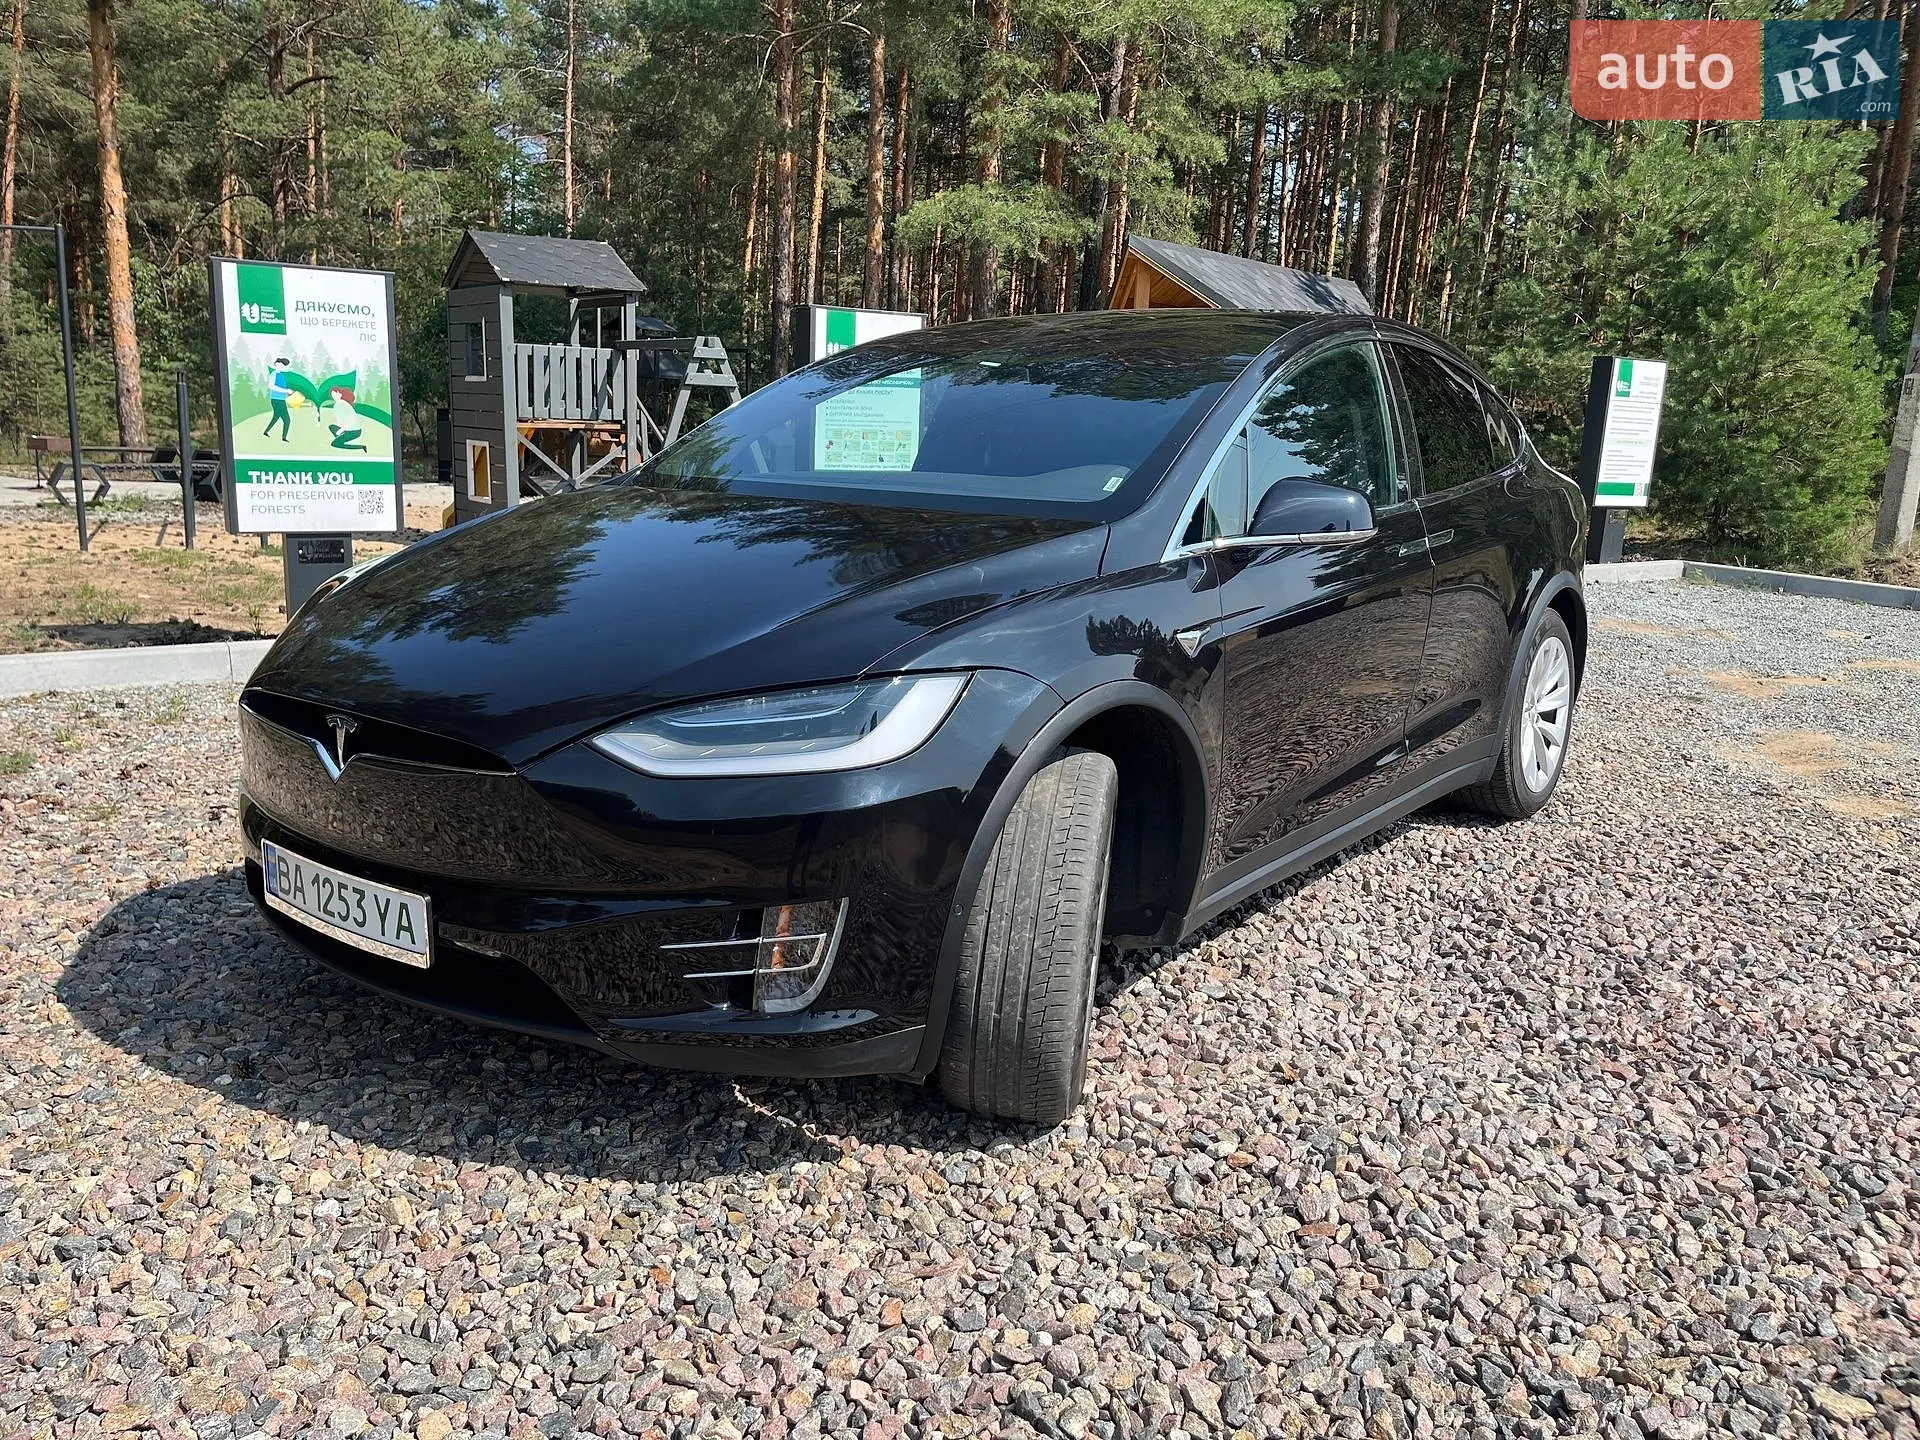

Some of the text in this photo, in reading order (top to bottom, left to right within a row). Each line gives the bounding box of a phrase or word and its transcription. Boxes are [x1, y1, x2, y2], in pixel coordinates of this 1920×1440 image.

[295, 300, 376, 318] ДЯКУЄМО,
[300, 316, 377, 330] ЩО БЕРЕЖЕТЕ
[359, 332, 377, 342] ЛІС
[248, 471, 354, 485] THANK YOU
[250, 490, 355, 501] FOR PRESERVING
[251, 504, 306, 515] FORESTS
[277, 855, 416, 945] BA 1253 YA
